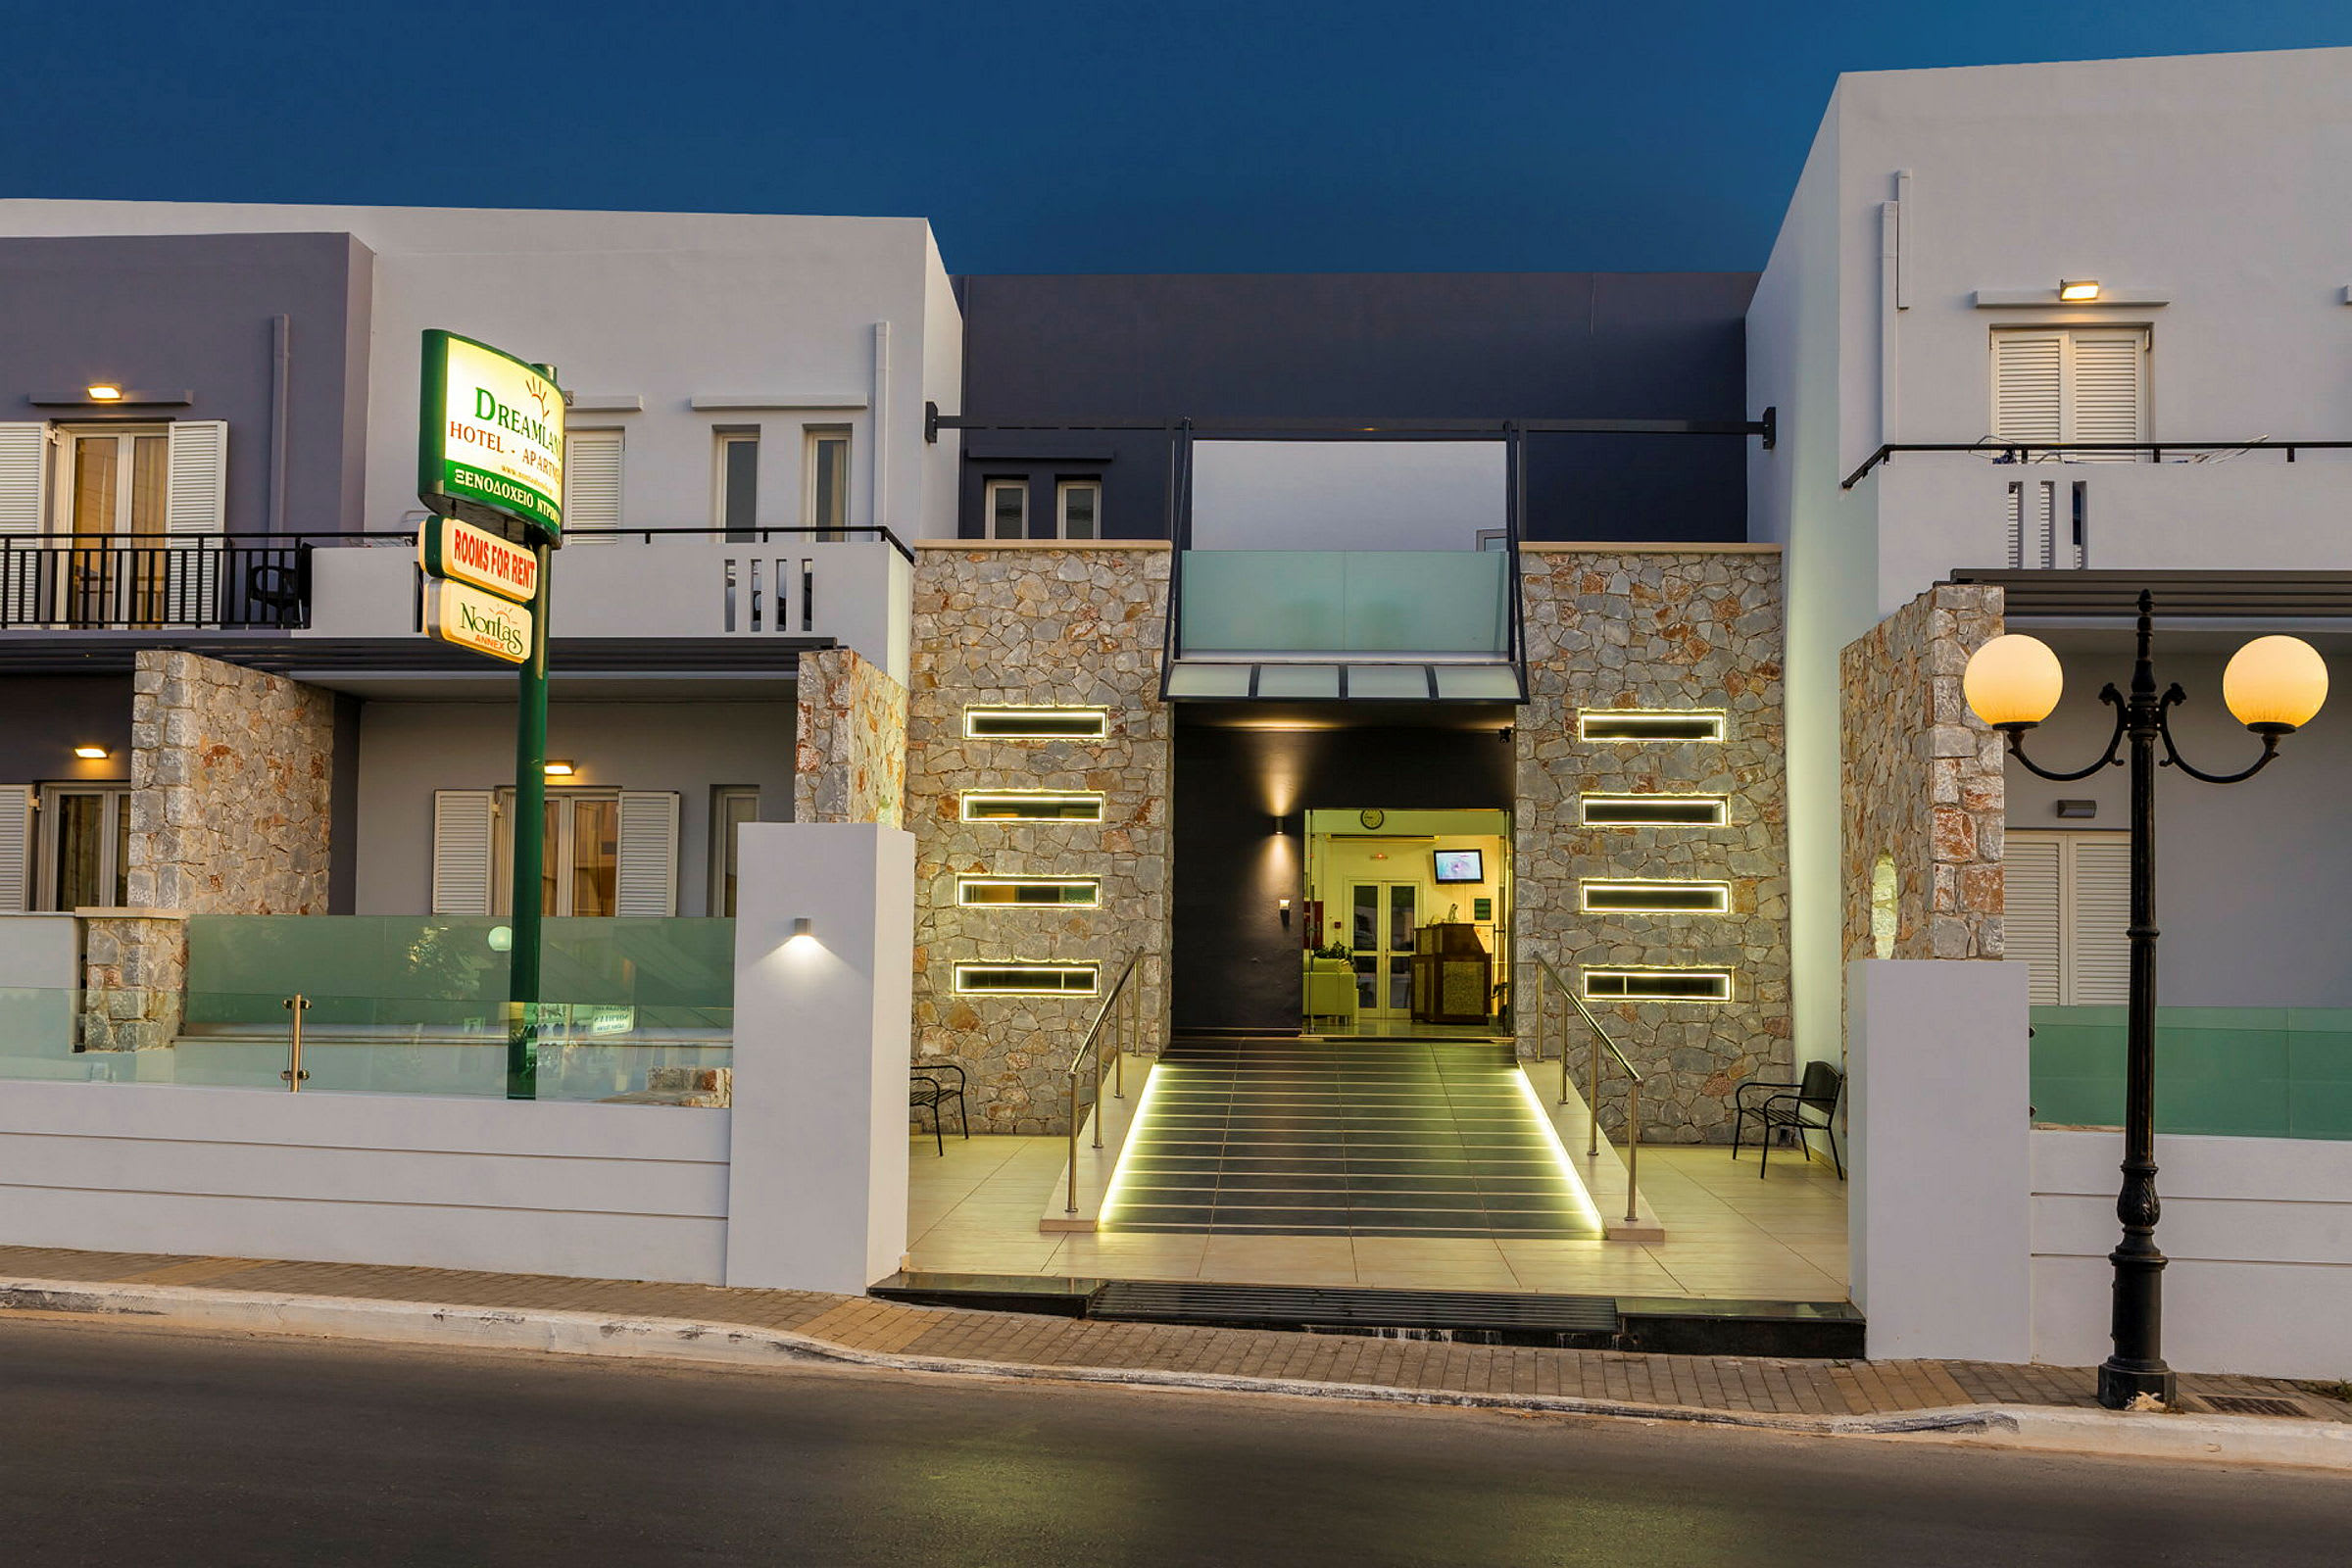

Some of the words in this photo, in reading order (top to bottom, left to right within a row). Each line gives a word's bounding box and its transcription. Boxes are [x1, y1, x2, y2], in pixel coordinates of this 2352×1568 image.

[450, 420, 504, 454] HOTEL
[474, 386, 562, 462] DREAMLAN
[455, 468, 534, 509] ΞΕΝΟΔΟΧΕΙΟ
[454, 529, 489, 572] ROOMS
[490, 545, 510, 580] FOR
[512, 554, 535, 590] RENT
[474, 634, 505, 651] ANNEX
